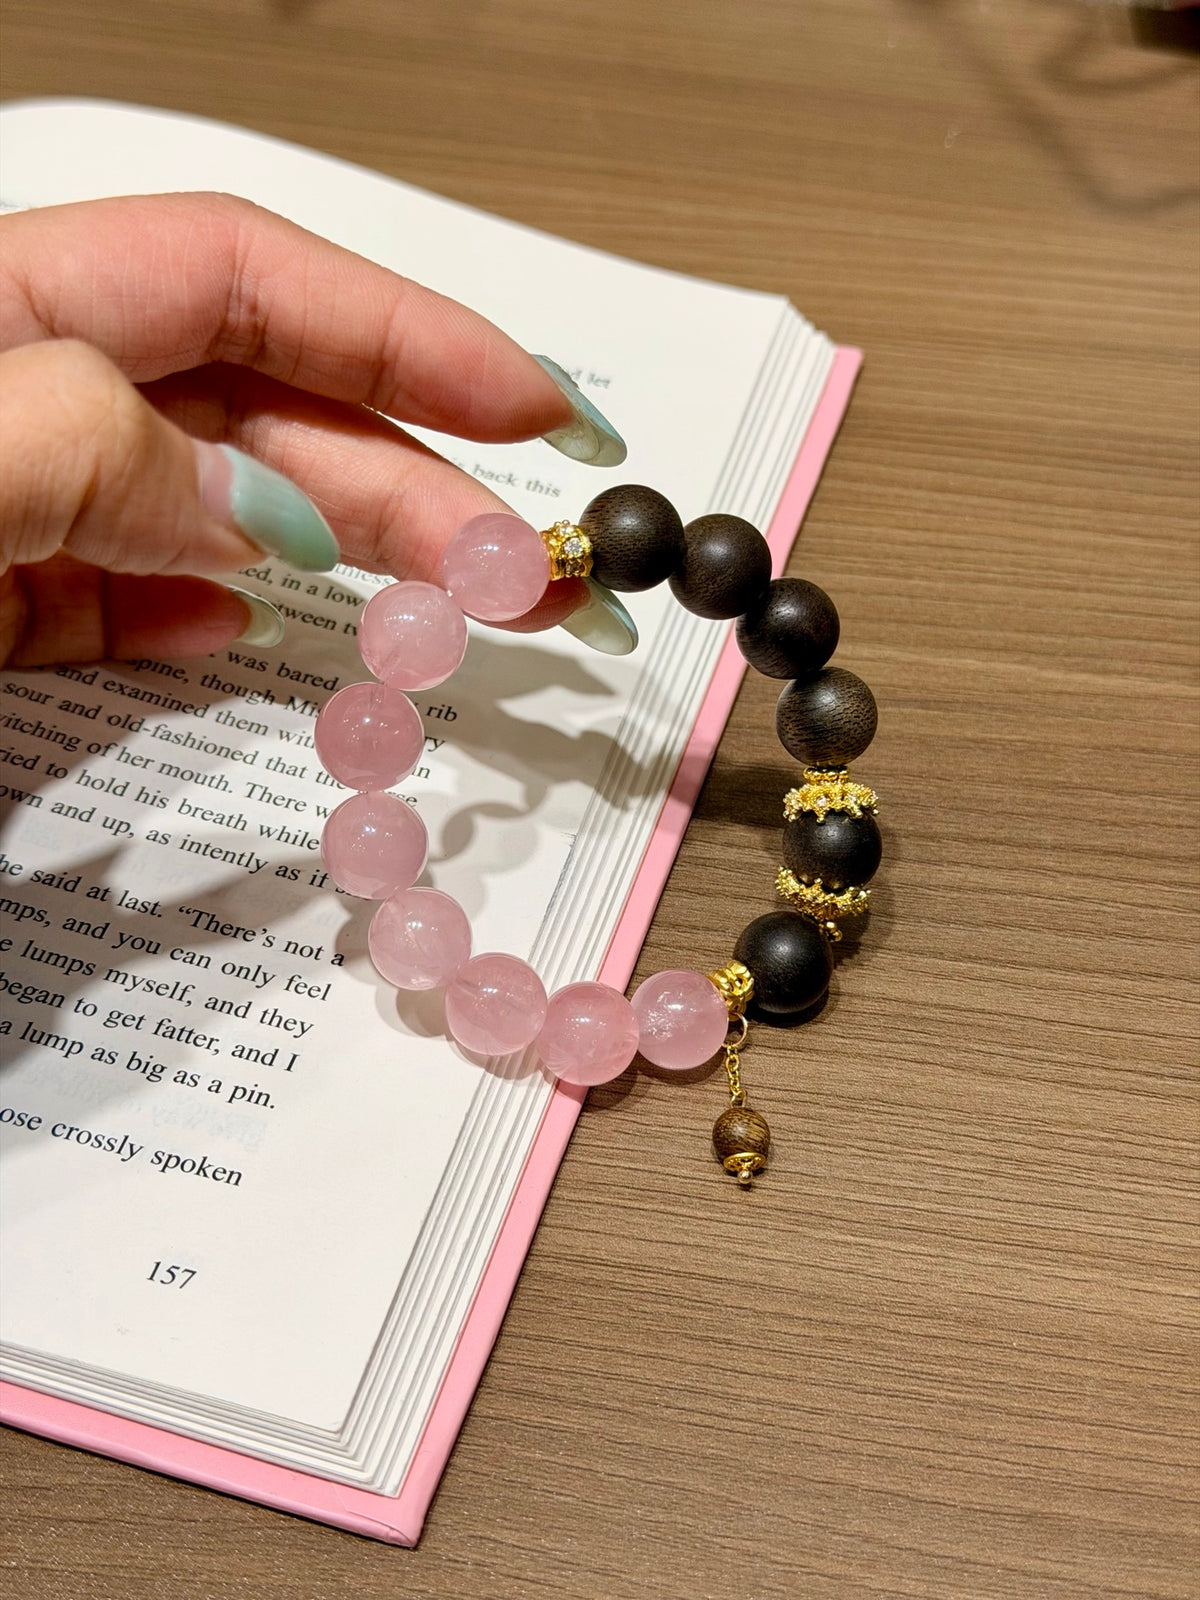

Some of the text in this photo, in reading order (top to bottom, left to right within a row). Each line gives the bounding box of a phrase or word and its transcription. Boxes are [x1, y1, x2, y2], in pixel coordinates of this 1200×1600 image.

[472, 463, 561, 499] back this
[238, 567, 364, 607] ed, in a low
[55, 665, 99, 685] and
[102, 679, 211, 718] examined
[215, 710, 269, 736] them
[200, 673, 276, 705] though
[228, 651, 269, 672] was
[426, 704, 458, 722] rib
[2, 682, 54, 705] sour
[58, 700, 102, 720] and
[106, 713, 260, 765] old-fashioned
[265, 757, 309, 779] that
[46, 762, 69, 779] to
[75, 769, 131, 797] hold
[133, 786, 170, 809] his
[177, 798, 248, 831] breath
[259, 824, 320, 850] while
[87, 741, 118, 757] of
[116, 746, 155, 769] her
[157, 762, 233, 793] mouth.
[245, 781, 307, 812] There
[50, 802, 97, 823] and
[102, 815, 135, 839] up,
[145, 829, 172, 845] as
[178, 833, 268, 874] intently
[275, 864, 301, 881] as
[309, 869, 330, 888] if
[30, 869, 82, 893] said
[86, 886, 111, 901] at
[117, 890, 162, 918] last.
[283, 940, 325, 960] not
[331, 952, 345, 967] a
[21, 940, 315, 1039] lumps myself, and they
[62, 917, 110, 939] and
[111, 931, 161, 954] you
[169, 947, 212, 969] can
[221, 962, 276, 989] only
[283, 974, 332, 1001] feel
[0, 971, 300, 1073] began to get fatter, and I
[0, 1020, 275, 1109] a lump as big as a pin.
[51, 1122, 144, 1162] crossly
[150, 1150, 242, 1187] spoken
[146, 1261, 197, 1289] 157
